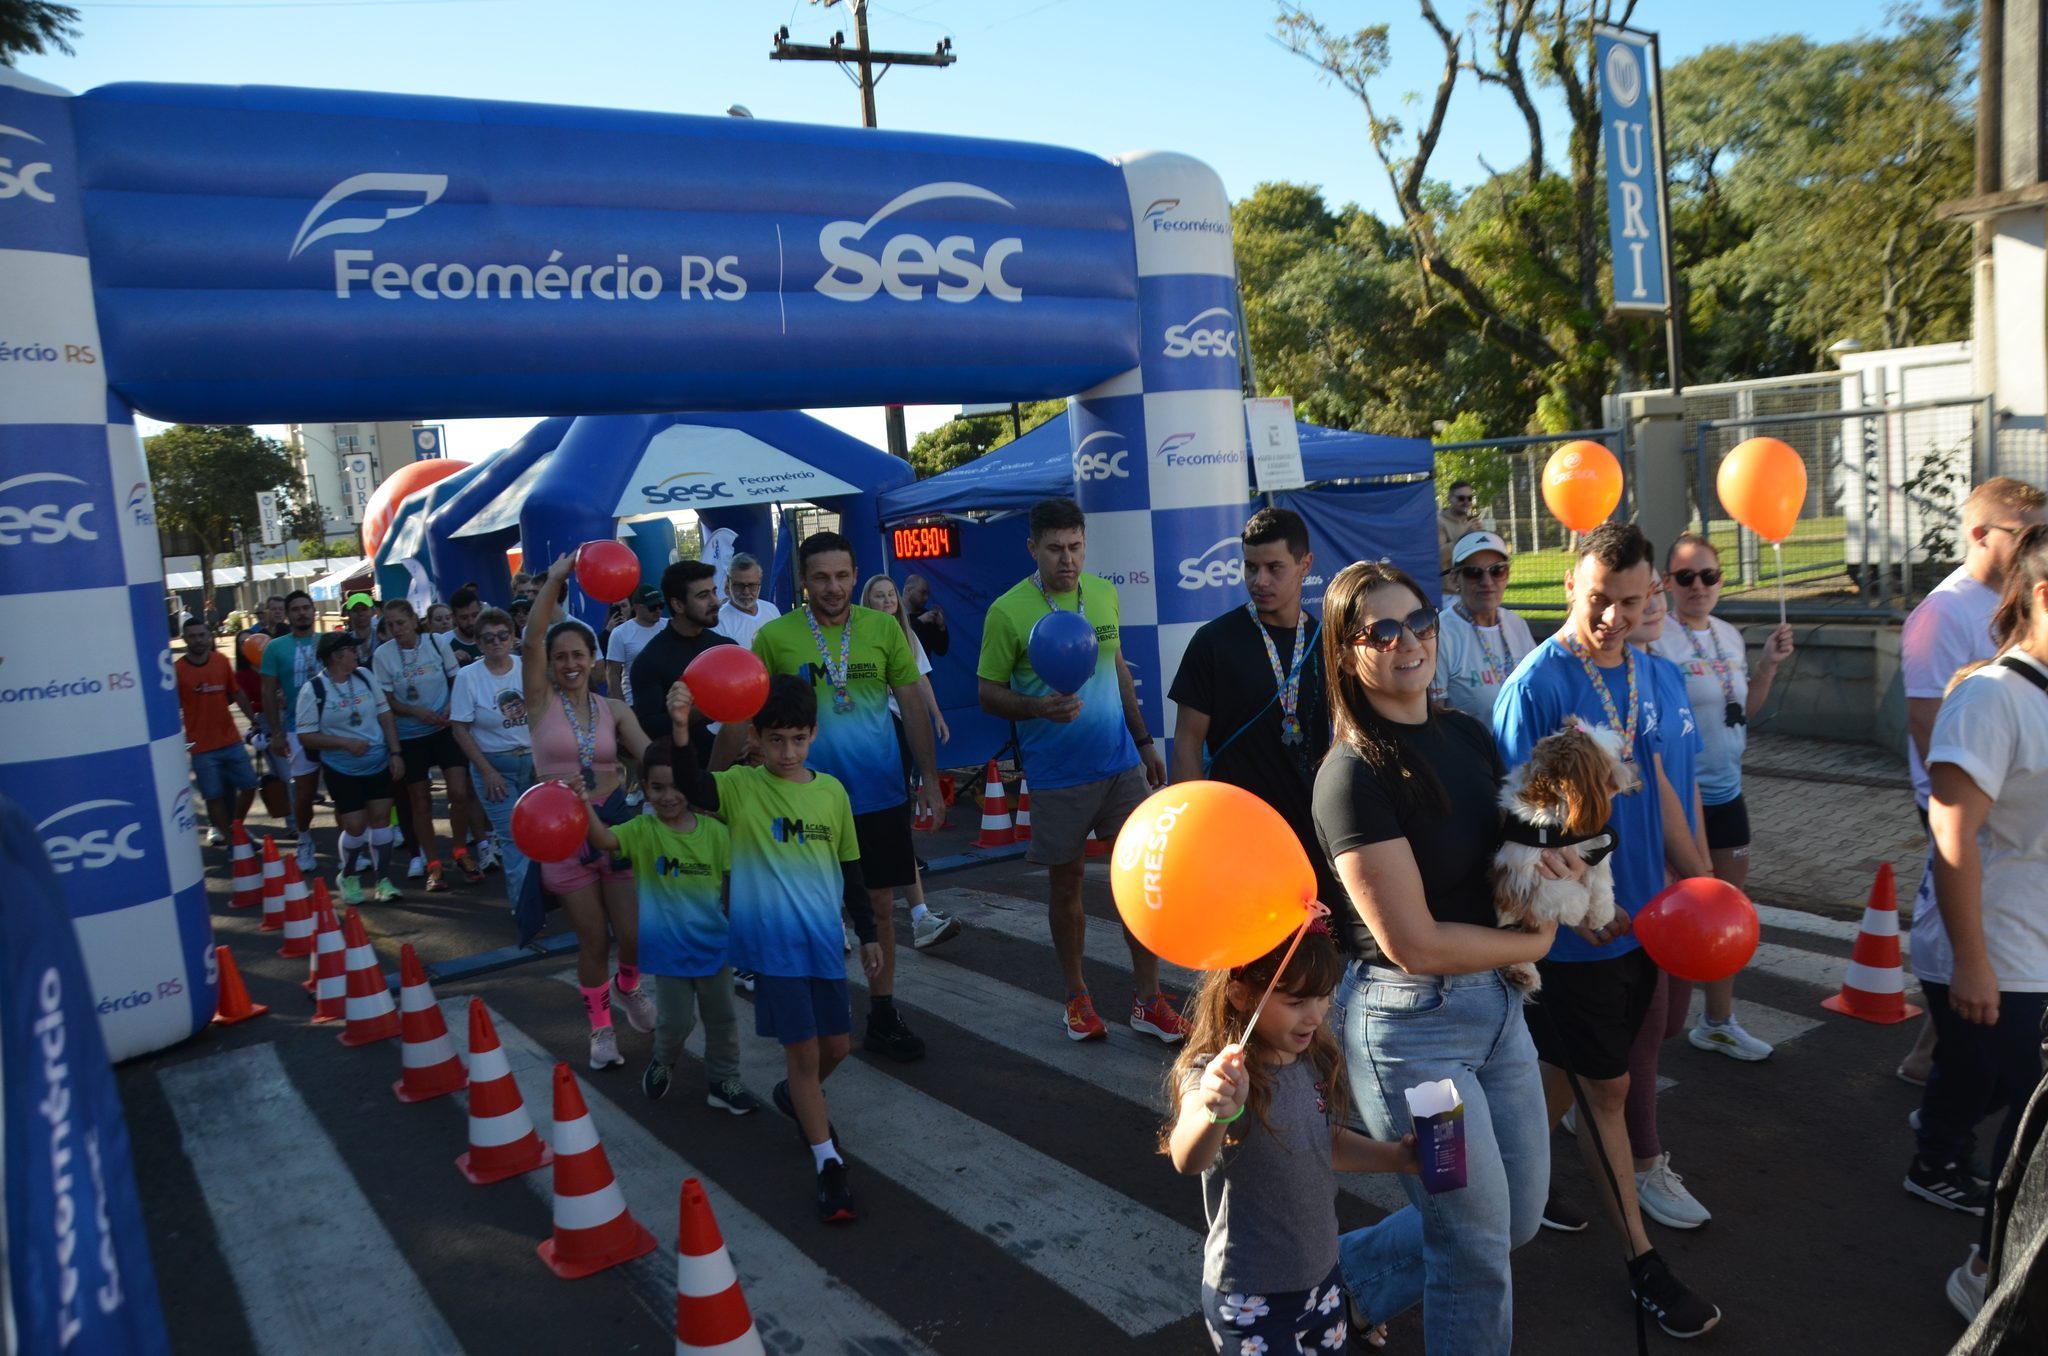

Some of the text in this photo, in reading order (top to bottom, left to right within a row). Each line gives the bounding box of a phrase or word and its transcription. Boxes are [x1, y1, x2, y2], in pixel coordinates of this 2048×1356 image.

[0, 157, 56, 203] sc
[1613, 119, 1649, 298] URI
[334, 250, 748, 301] Fecomércio RS
[814, 220, 1023, 303] Sesc
[0, 342, 97, 364] ércio RS
[1167, 450, 1239, 467] Fecomércio
[641, 471, 815, 504] Sesc Fecomércio
[0, 502, 99, 545] esc
[264, 508, 275, 541] URI
[894, 527, 949, 559] 00:59:04
[1129, 571, 1149, 585] RS
[1177, 557, 1244, 591] Ses
[847, 662, 877, 670] ADEMIA
[847, 671, 878, 680] RENCIO
[1, 672, 135, 703] omércio RS
[43, 822, 145, 873] esc
[1144, 802, 1189, 910] CRESOL
[97, 978, 183, 1014] ércio RS
